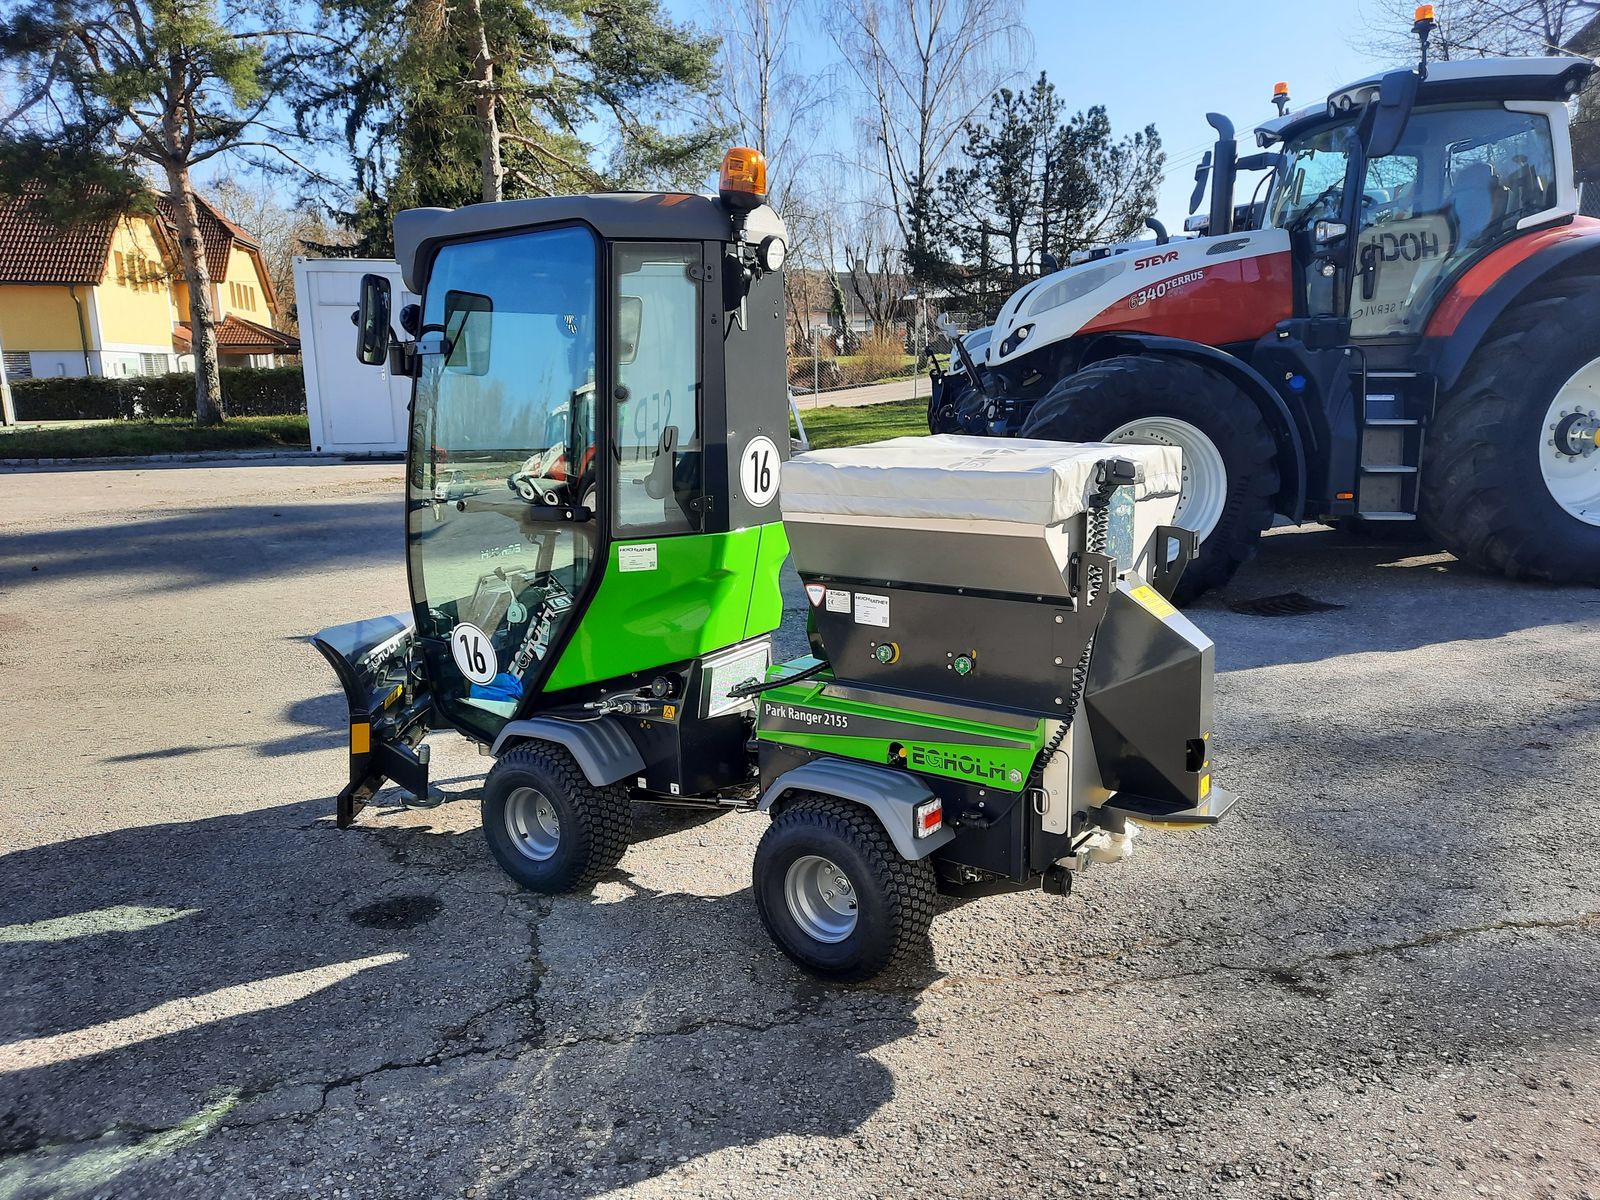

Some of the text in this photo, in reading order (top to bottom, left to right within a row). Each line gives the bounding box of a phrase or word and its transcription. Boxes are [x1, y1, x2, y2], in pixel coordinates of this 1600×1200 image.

[1134, 250, 1179, 271] STEYR
[1128, 270, 1204, 310] 6340 TERRUS
[750, 450, 771, 493] 16
[459, 634, 487, 675] 16
[765, 703, 848, 728] Park Ranger 2155
[911, 746, 1006, 782] EGHOLM
